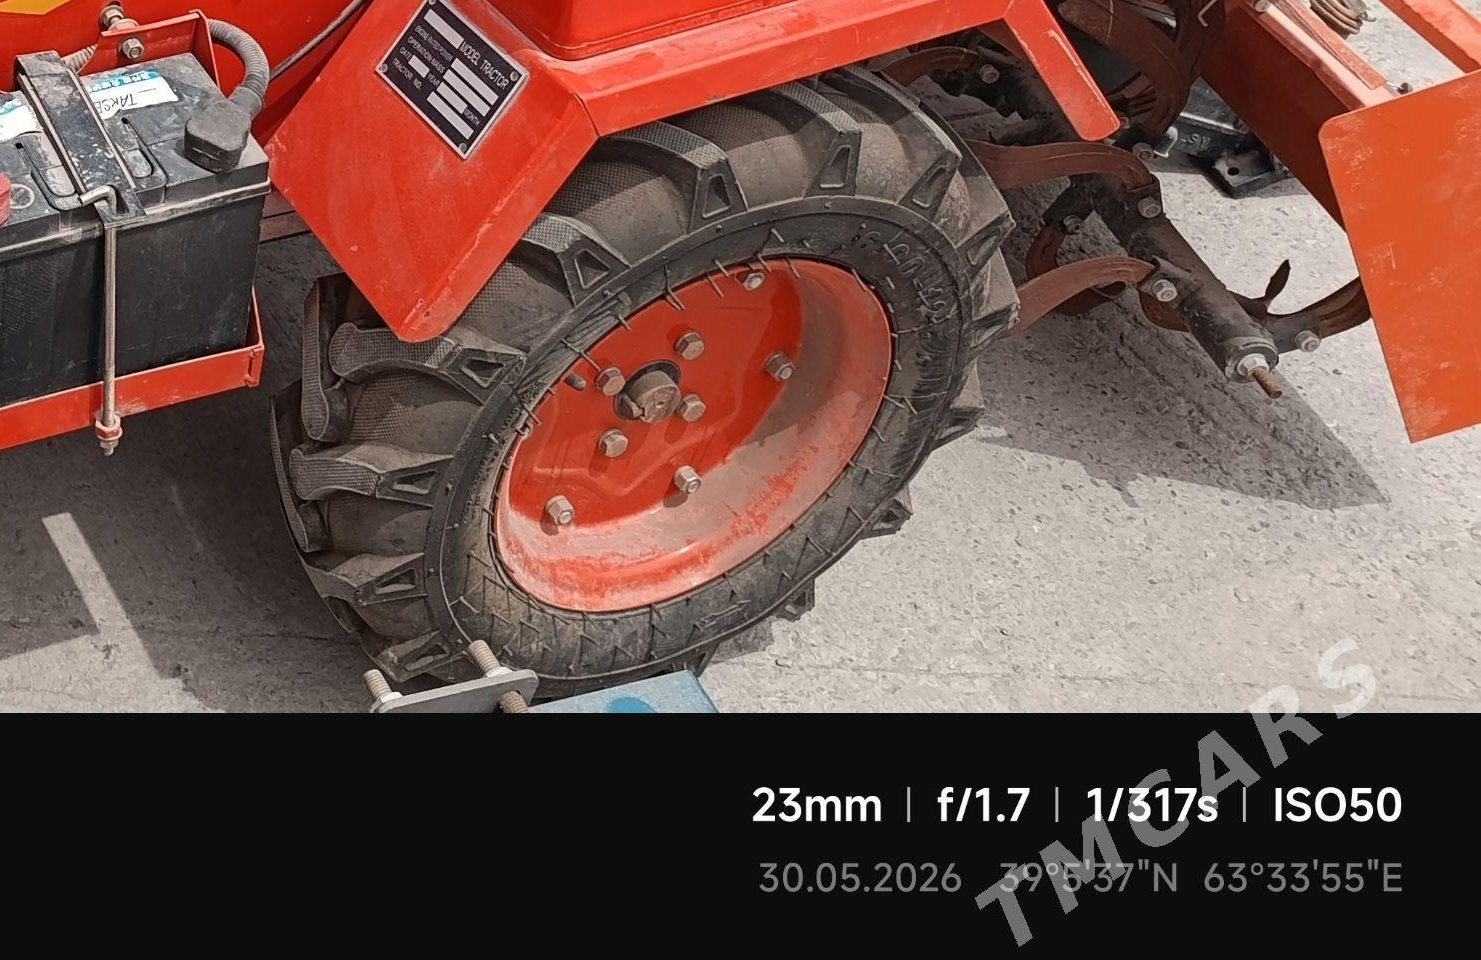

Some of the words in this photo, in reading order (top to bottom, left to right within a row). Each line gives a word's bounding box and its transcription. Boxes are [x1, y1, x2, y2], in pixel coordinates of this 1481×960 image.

[392, 57, 414, 81] TRACTOR
[407, 35, 433, 62] OPERATION
[430, 57, 446, 74] MASS
[459, 41, 481, 66] MODEL
[479, 59, 509, 90] TRACTOR
[399, 46, 413, 61] DATE
[427, 73, 441, 88] YEAR
[464, 108, 480, 127] MONTH
